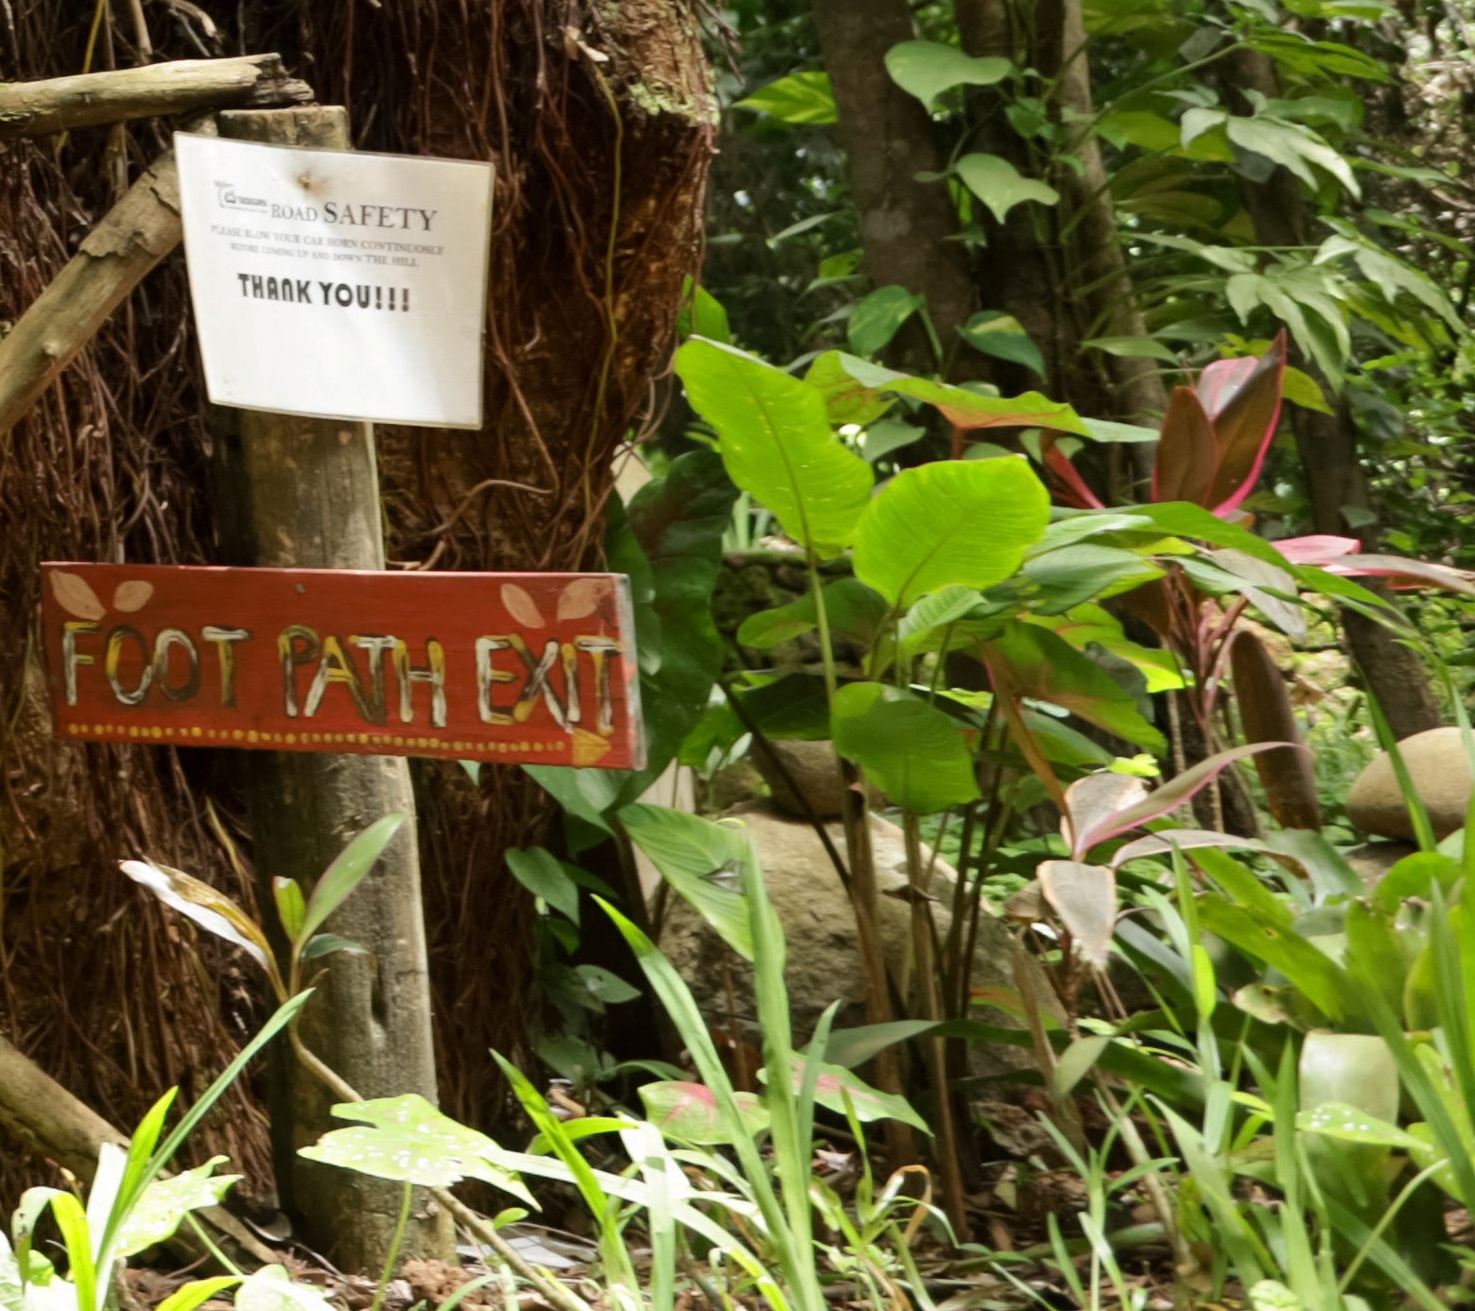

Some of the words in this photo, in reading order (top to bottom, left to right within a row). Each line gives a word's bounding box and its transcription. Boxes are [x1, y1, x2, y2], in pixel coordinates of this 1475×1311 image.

[271, 203, 318, 221] ROAD
[324, 201, 438, 231] SAFETY
[237, 273, 312, 304] THANK
[318, 280, 410, 312] YOU!!!
[62, 622, 253, 708] FOOT
[278, 625, 446, 728] PATH
[477, 633, 626, 737] EXIT
